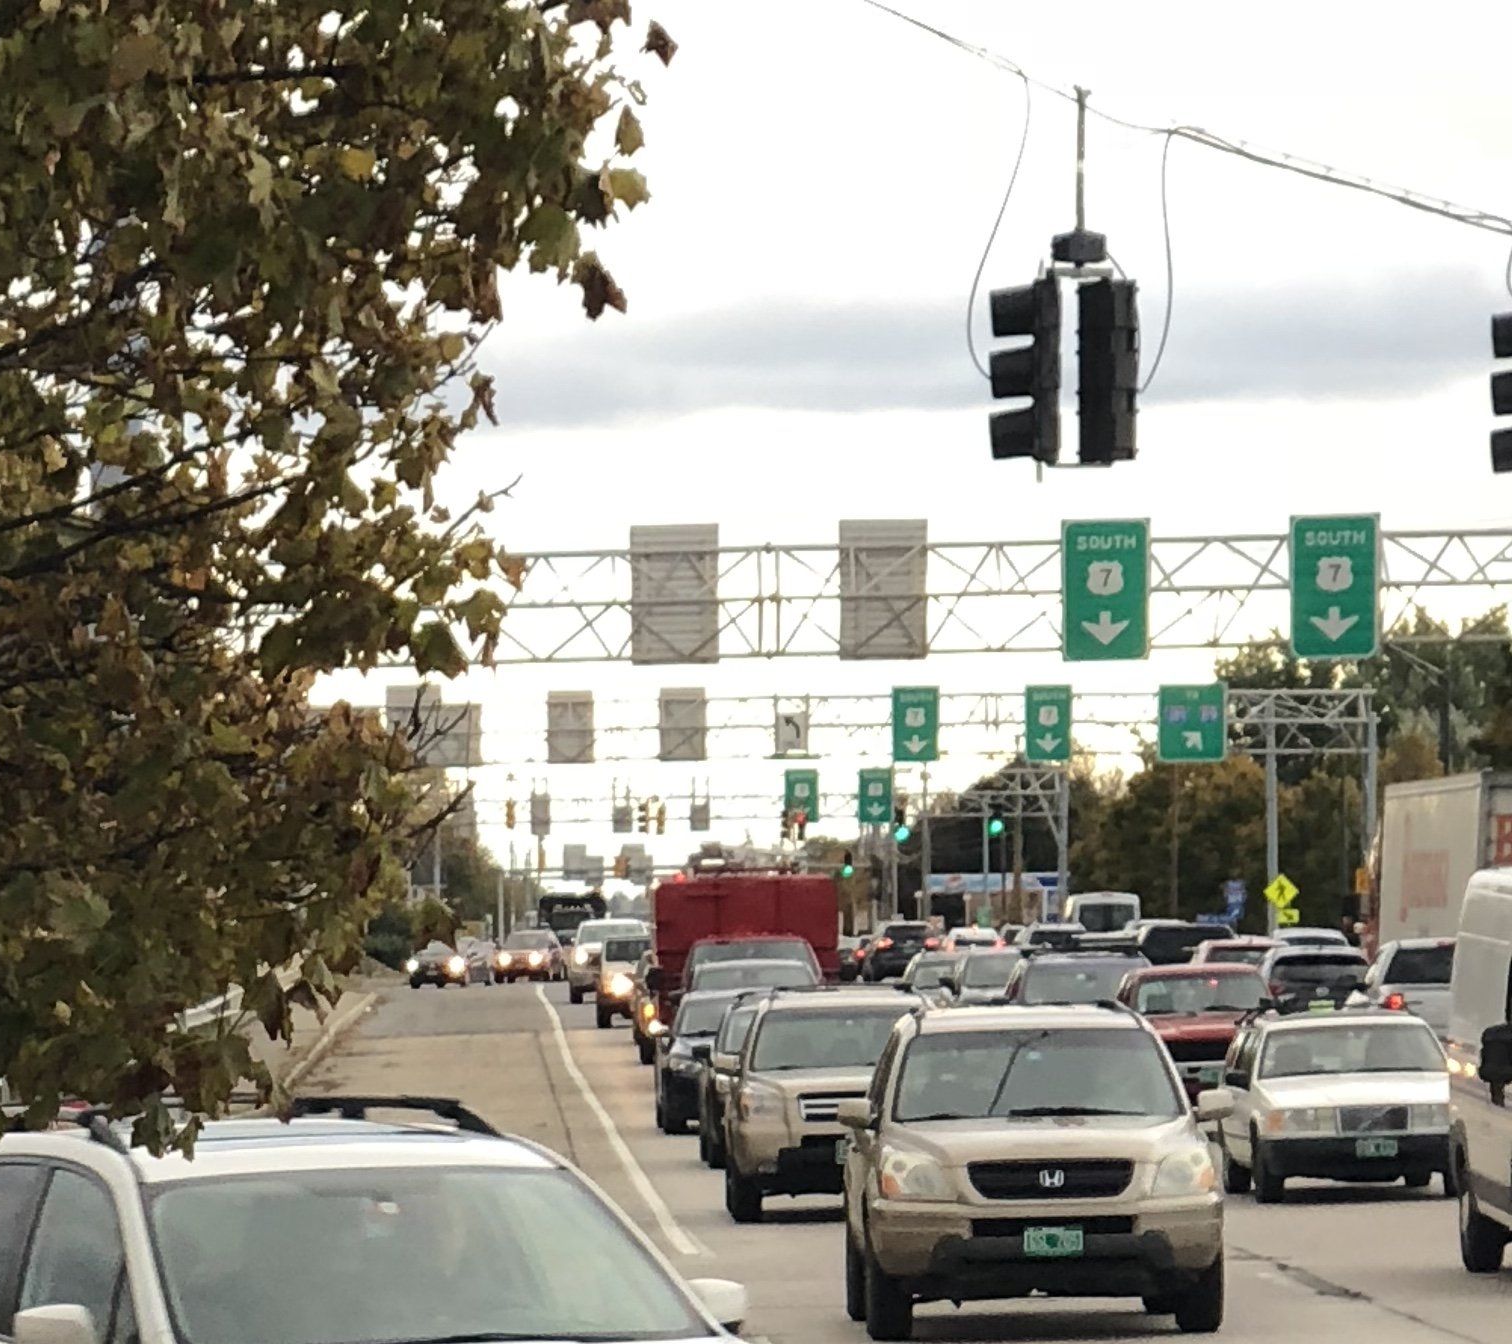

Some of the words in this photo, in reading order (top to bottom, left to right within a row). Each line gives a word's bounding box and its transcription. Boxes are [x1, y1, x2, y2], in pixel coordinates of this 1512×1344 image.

[1076, 534, 1137, 550] SOUTH
[1304, 530, 1366, 547] SOUTH
[1099, 568, 1113, 587] 7
[1328, 564, 1342, 582] 7
